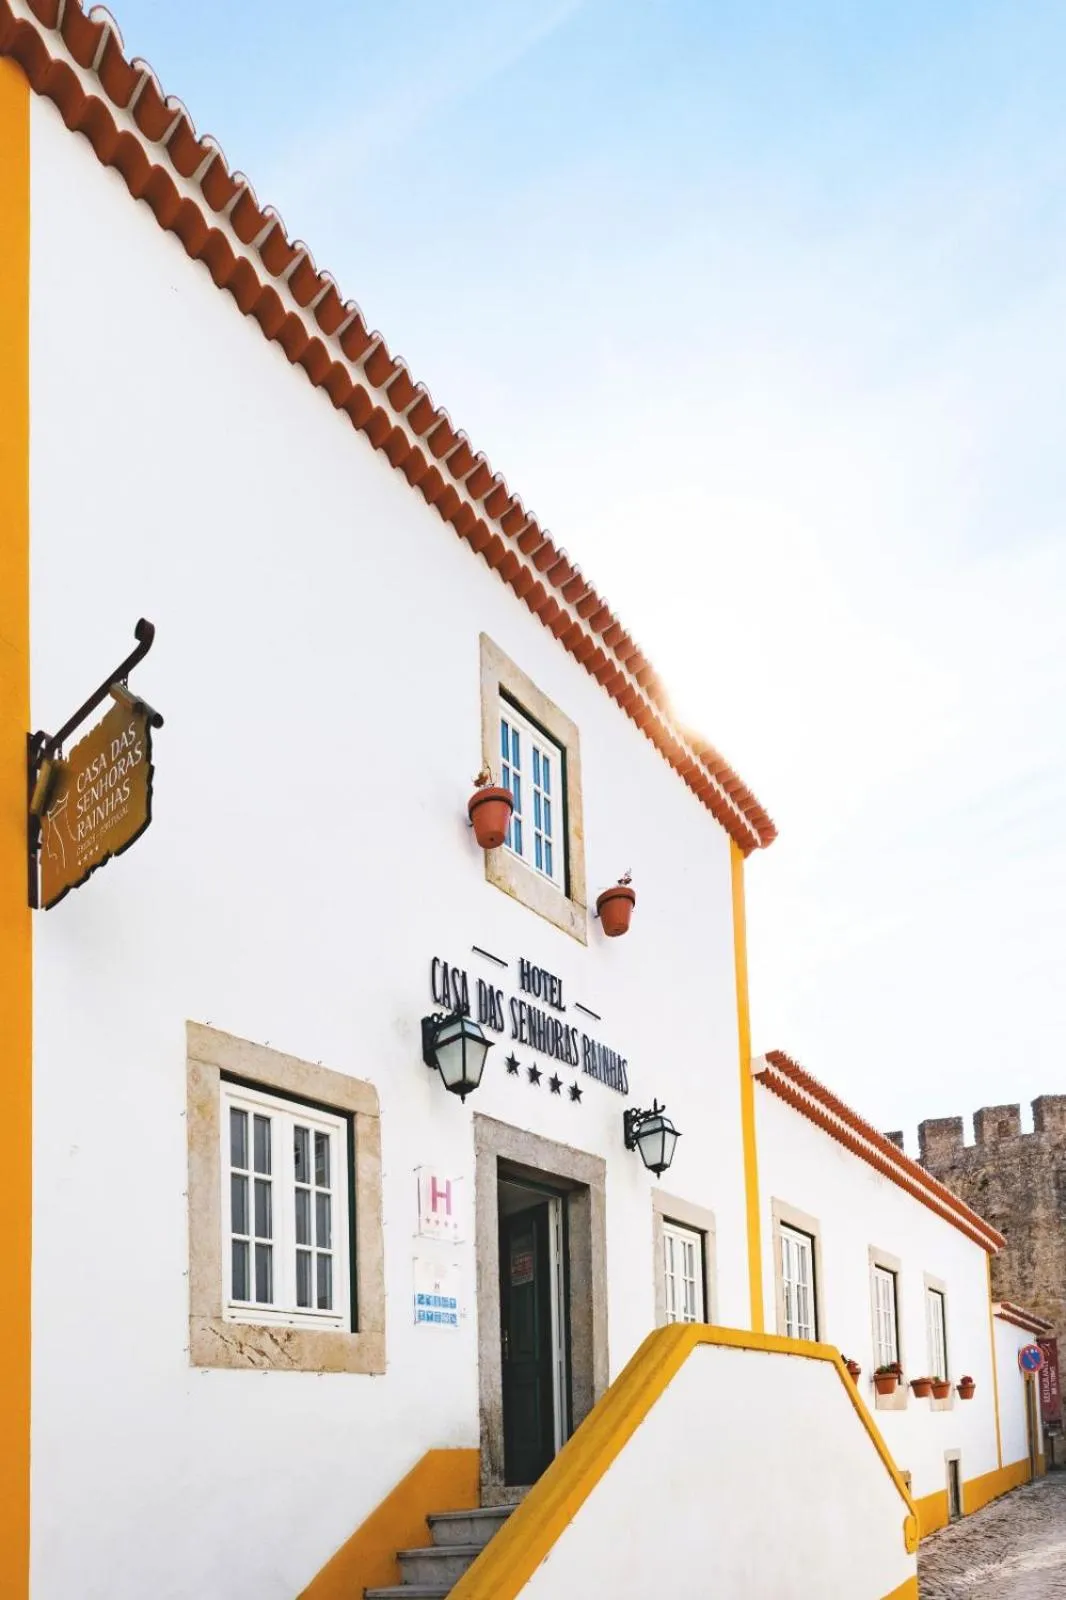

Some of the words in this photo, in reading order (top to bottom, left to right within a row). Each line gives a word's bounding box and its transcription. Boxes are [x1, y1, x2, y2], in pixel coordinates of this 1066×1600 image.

[76, 741, 143, 818] SENHORAS
[77, 752, 107, 793] CASA
[111, 722, 136, 760] DAS
[77, 778, 130, 841] RAINHAS
[520, 957, 566, 1012] HOTEL
[431, 956, 470, 1016] CASA
[477, 978, 504, 1032] DAS
[510, 996, 579, 1066] SENHORAS
[582, 1034, 629, 1095] RAINHAS
[431, 1176, 451, 1215] H
